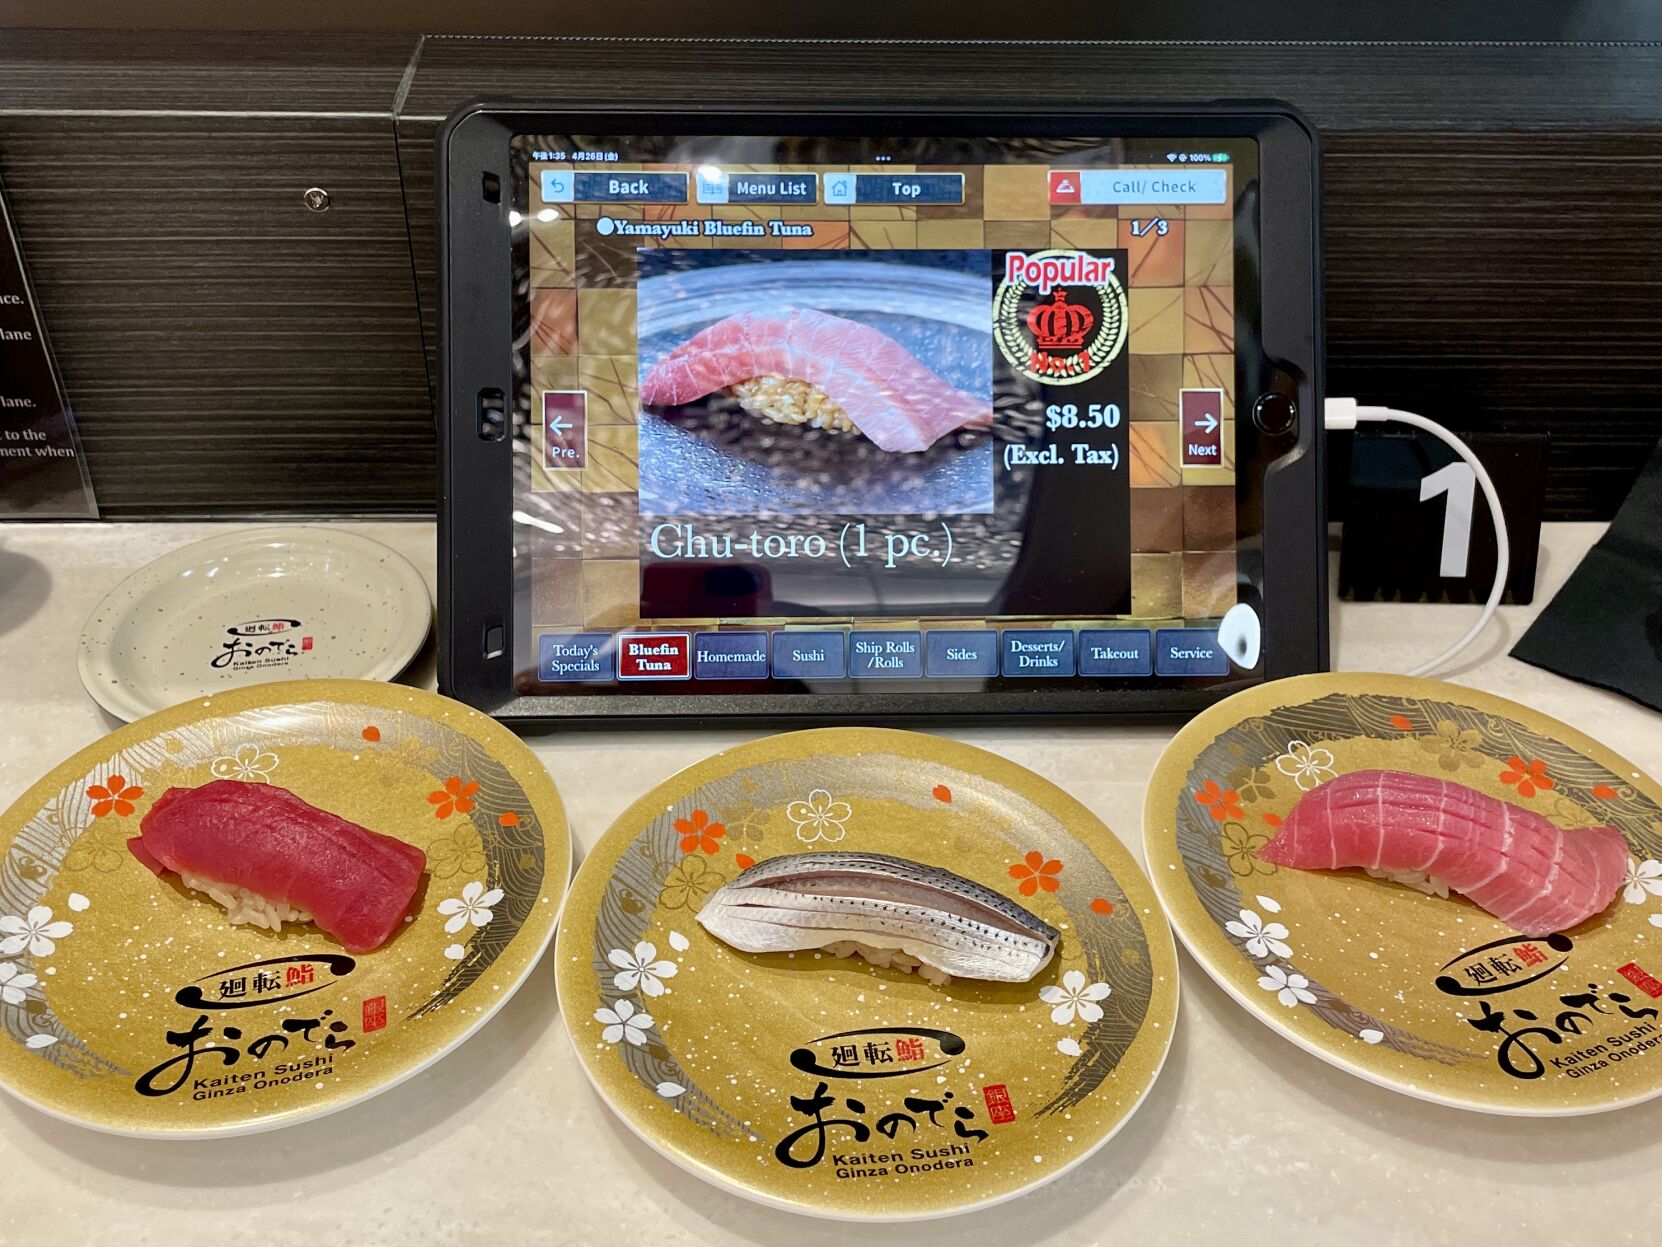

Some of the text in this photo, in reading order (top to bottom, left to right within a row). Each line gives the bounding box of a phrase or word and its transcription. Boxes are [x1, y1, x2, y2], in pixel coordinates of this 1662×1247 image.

[609, 179, 649, 194] Back
[737, 181, 807, 195] Menu List
[892, 182, 921, 198] Top
[1113, 180, 1196, 195] Call/ Check
[614, 219, 813, 239] Yamayuki Bluefin Tuna
[1131, 216, 1169, 236] 1/3
[1007, 254, 1112, 293] Popular
[1046, 404, 1121, 432] $8.50
[5, 430, 20, 440] to
[23, 429, 47, 441] the
[35, 445, 75, 457] when
[552, 447, 580, 458] Pre.
[1003, 443, 1120, 470] (Excl. Tax)
[1188, 444, 1217, 456] Next
[1419, 461, 1476, 577] 1
[651, 522, 952, 567] Chu-toro (1 pc.)
[211, 638, 299, 668] おのでら
[552, 644, 599, 659] Today's
[628, 643, 679, 656] Bluefin
[855, 641, 915, 656] Ship Rolls
[946, 648, 978, 660] Sides
[1010, 640, 1066, 652] Desserts/
[1091, 647, 1140, 660] Takeout
[1170, 647, 1213, 659] Service
[697, 651, 766, 663] Homemade
[792, 650, 825, 662] Sushi
[867, 656, 904, 668] /Rolls
[1018, 655, 1059, 667] Drinks
[551, 660, 600, 674] Specials
[636, 659, 672, 671] Tuna
[1464, 943, 1549, 987] 廻転鮨
[218, 964, 315, 1000] 廻転鮨
[1467, 983, 1659, 1080] おのでら
[135, 1009, 356, 1097] おのでら
[831, 1038, 924, 1068] 廻転鮨
[1549, 1021, 1657, 1069] Kaiten Sushi
[193, 1053, 333, 1091] Kaiten Sushi
[1565, 1058, 1610, 1079] Ginza
[192, 1066, 333, 1101] Ginza Onodera
[775, 1082, 989, 1168] おのでら
[832, 1143, 970, 1166] Kaiten Sushi
[836, 1158, 974, 1179] Ginza Onodera
